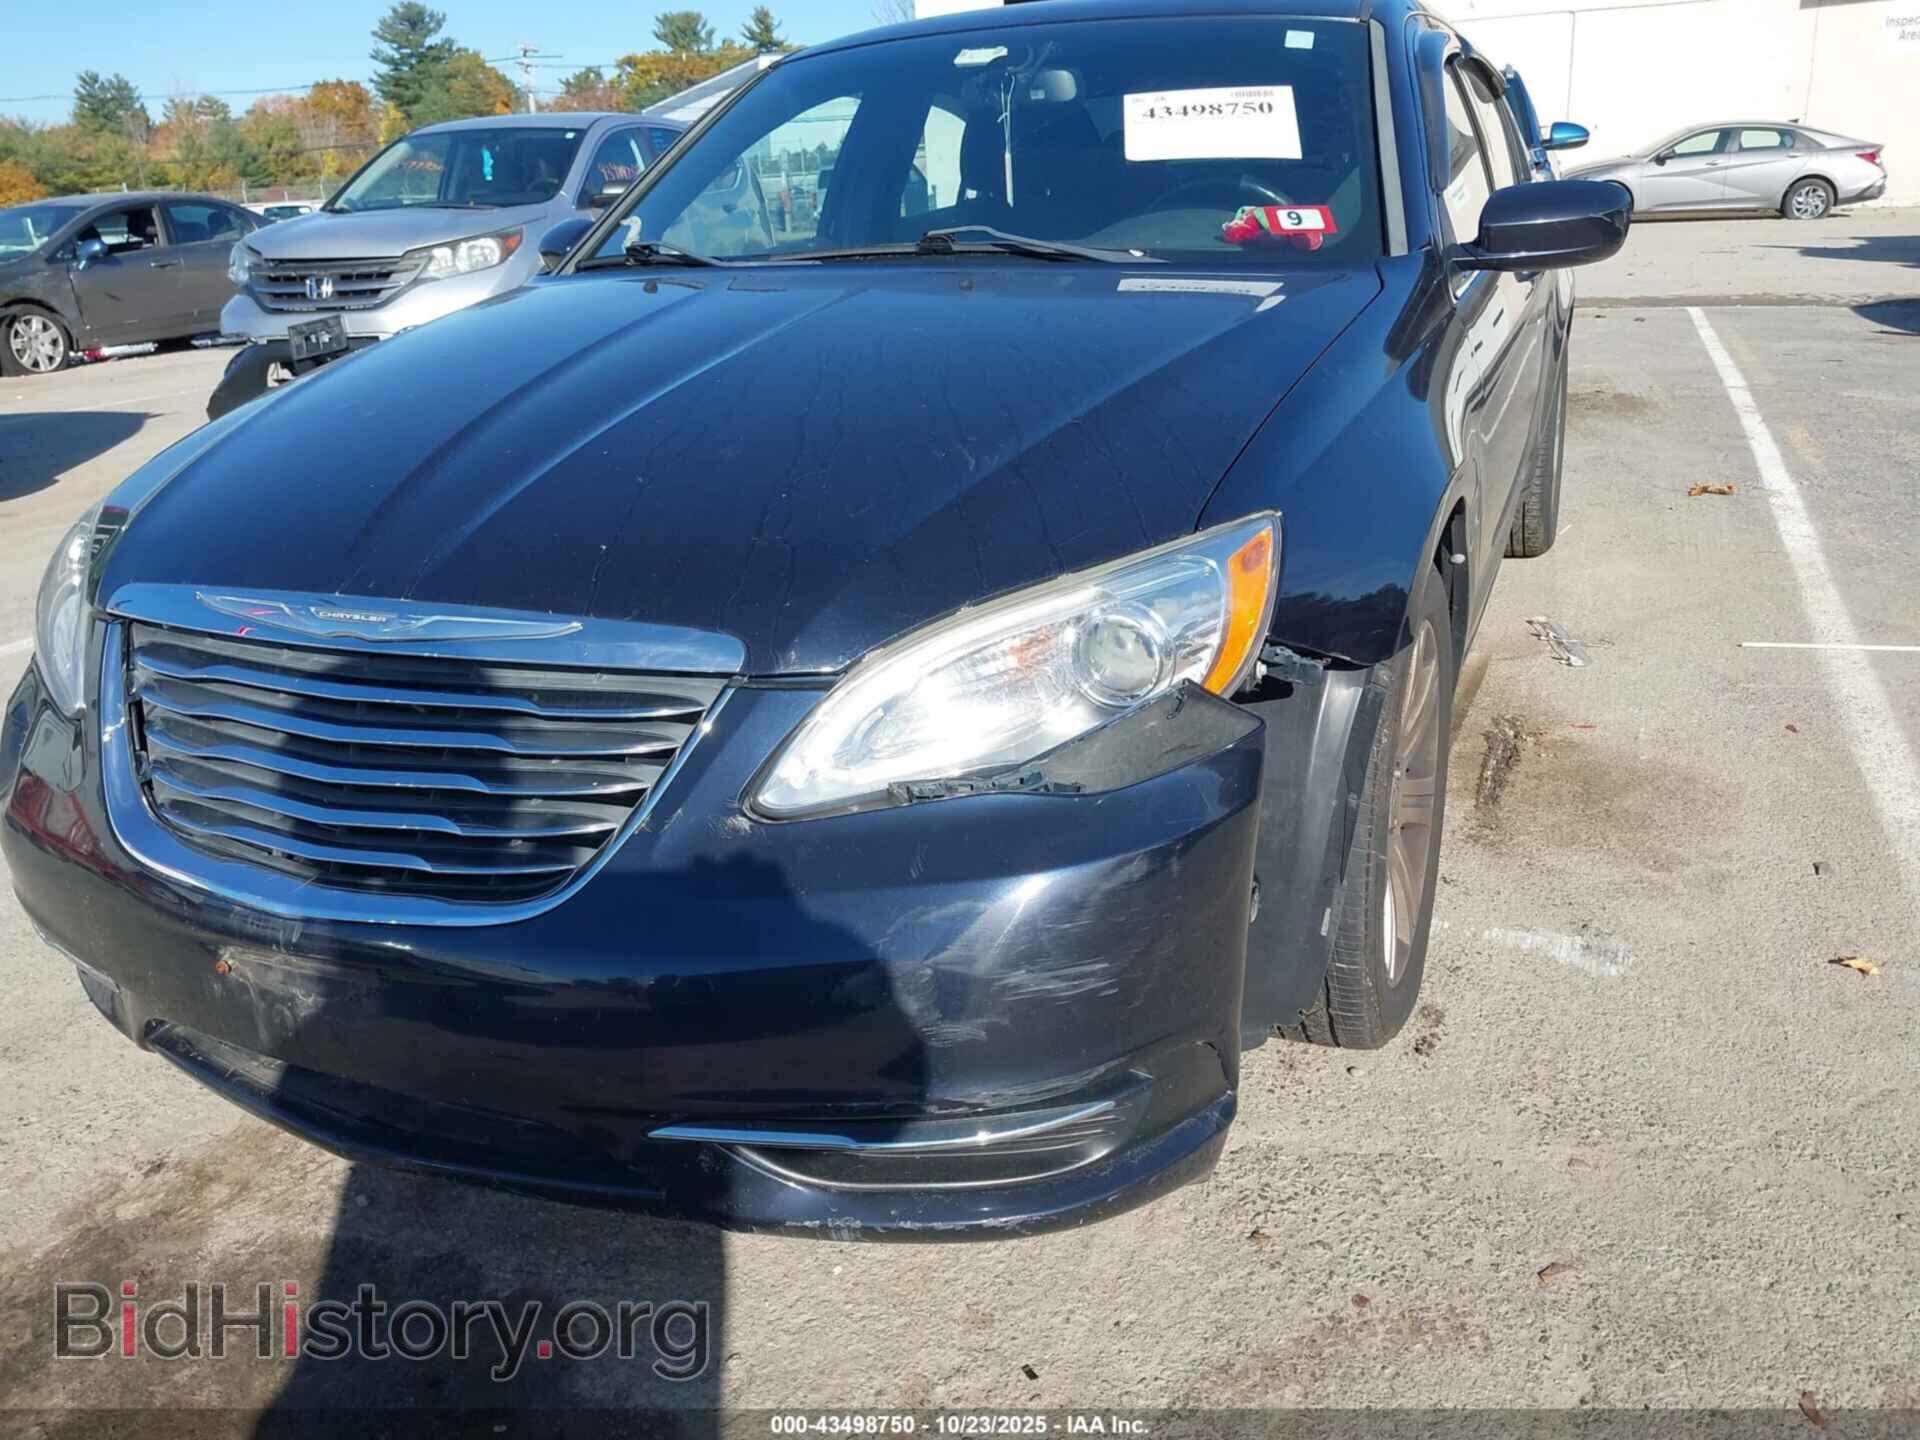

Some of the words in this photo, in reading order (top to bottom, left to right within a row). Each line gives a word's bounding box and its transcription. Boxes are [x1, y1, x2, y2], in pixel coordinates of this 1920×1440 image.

[1142, 101, 1274, 119] 43498750
[1287, 210, 1303, 226] 9
[319, 611, 387, 623] CHRYSLER
